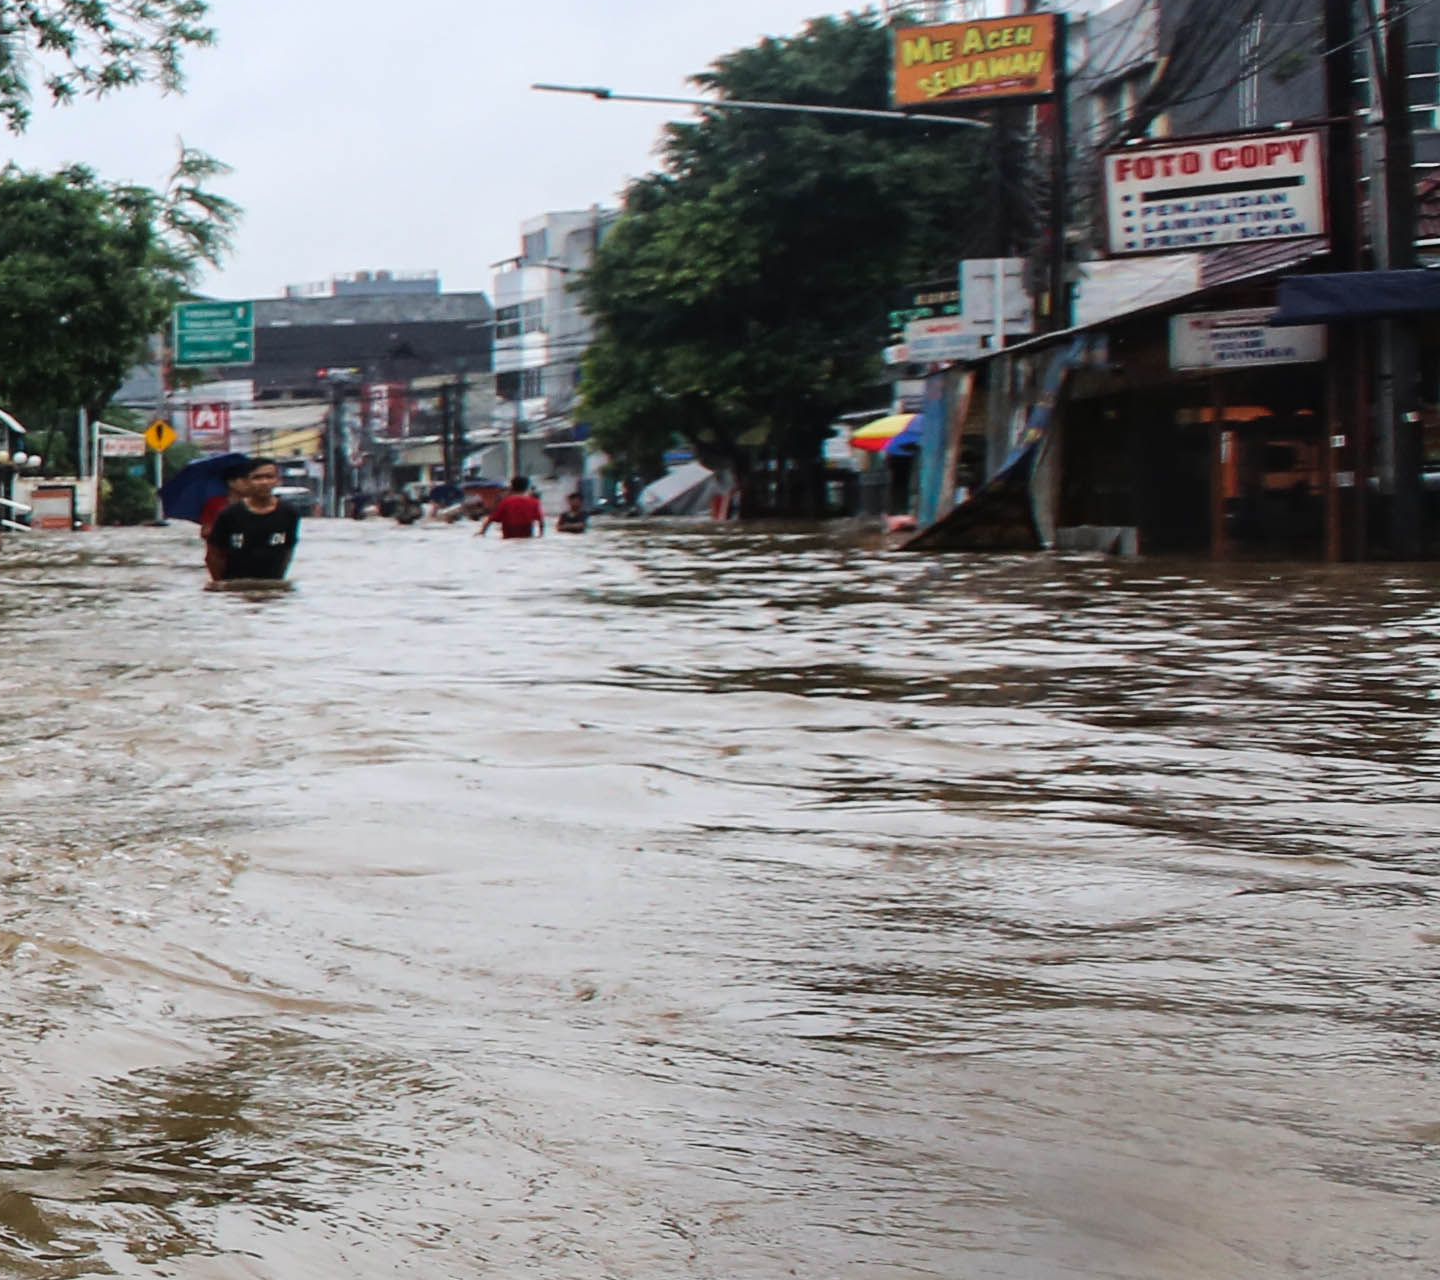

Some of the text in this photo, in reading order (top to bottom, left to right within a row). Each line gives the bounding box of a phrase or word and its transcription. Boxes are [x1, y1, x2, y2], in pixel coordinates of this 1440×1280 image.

[1113, 139, 1309, 182] FOTO COPY
[1142, 207, 1296, 233] LAMINATING
[1143, 230, 1217, 248] PRINT
[1239, 222, 1306, 240] SCAN
